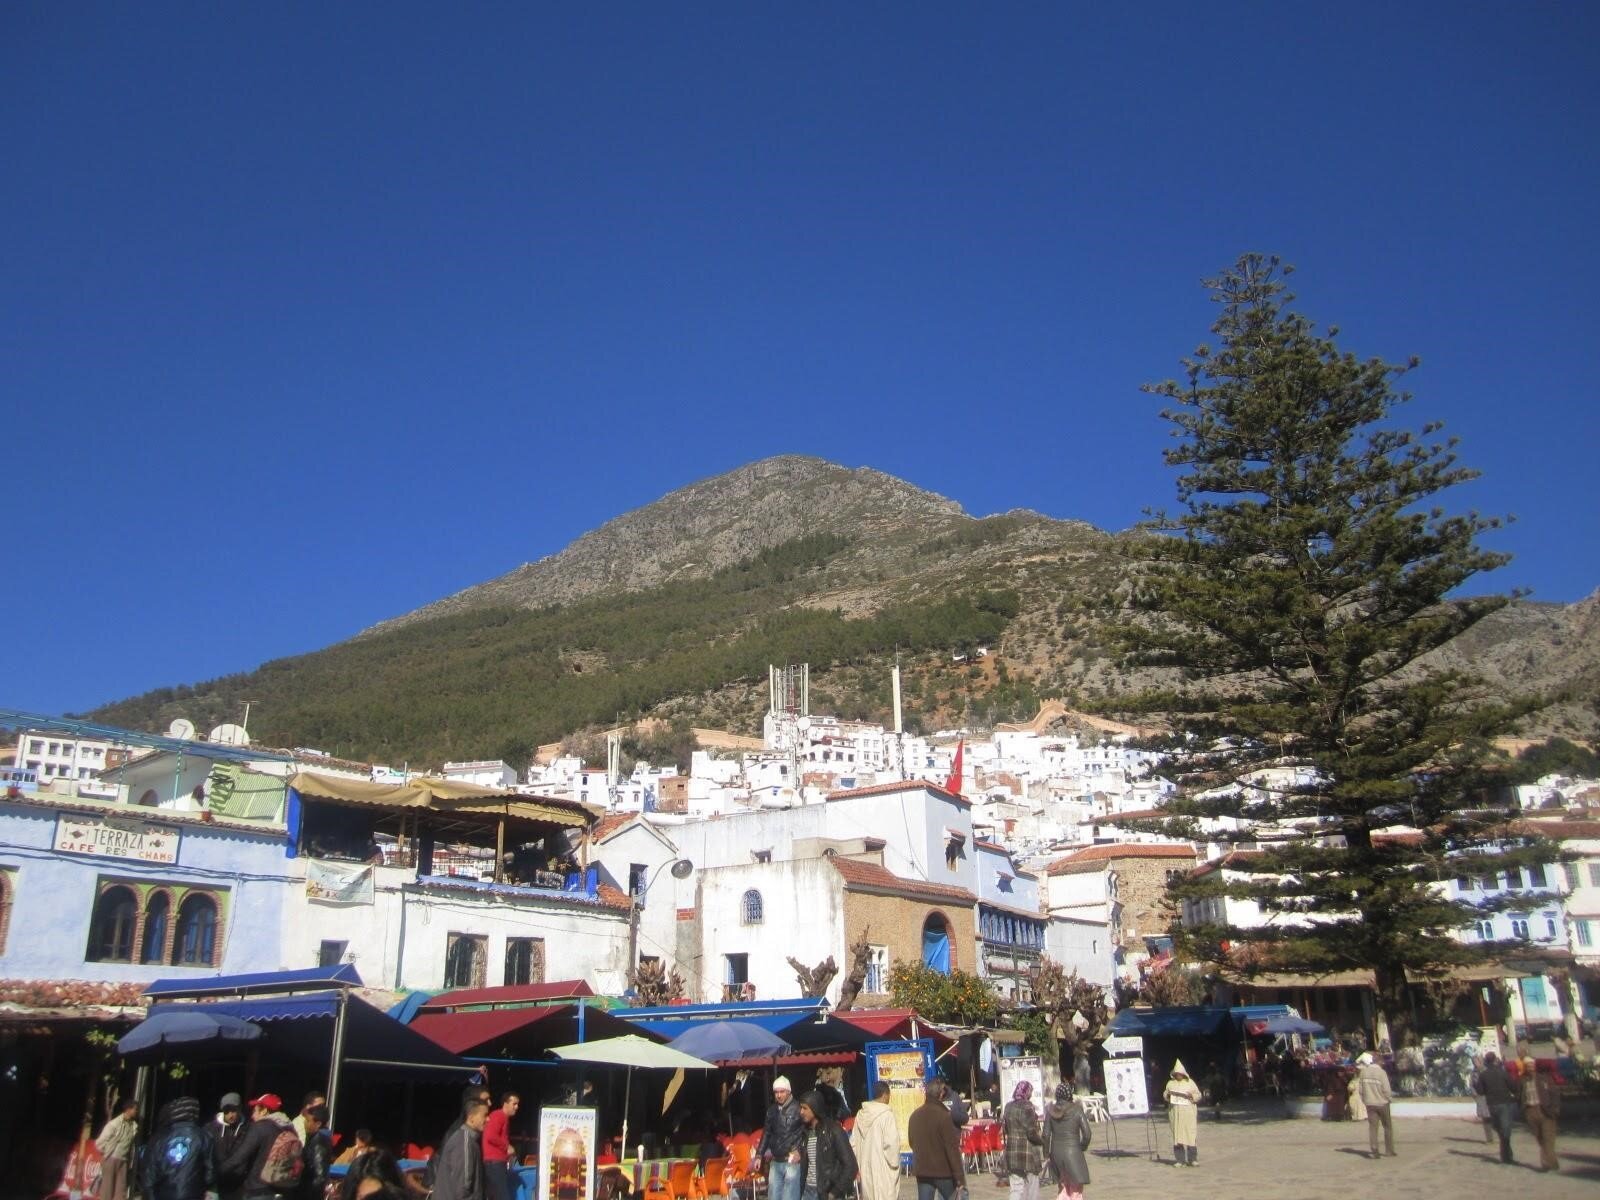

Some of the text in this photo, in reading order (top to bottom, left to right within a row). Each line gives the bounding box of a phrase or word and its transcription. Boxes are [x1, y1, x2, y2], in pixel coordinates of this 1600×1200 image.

[94, 828, 144, 850] TERRAZA
[60, 841, 95, 853] CAFE
[105, 848, 128, 857] RES
